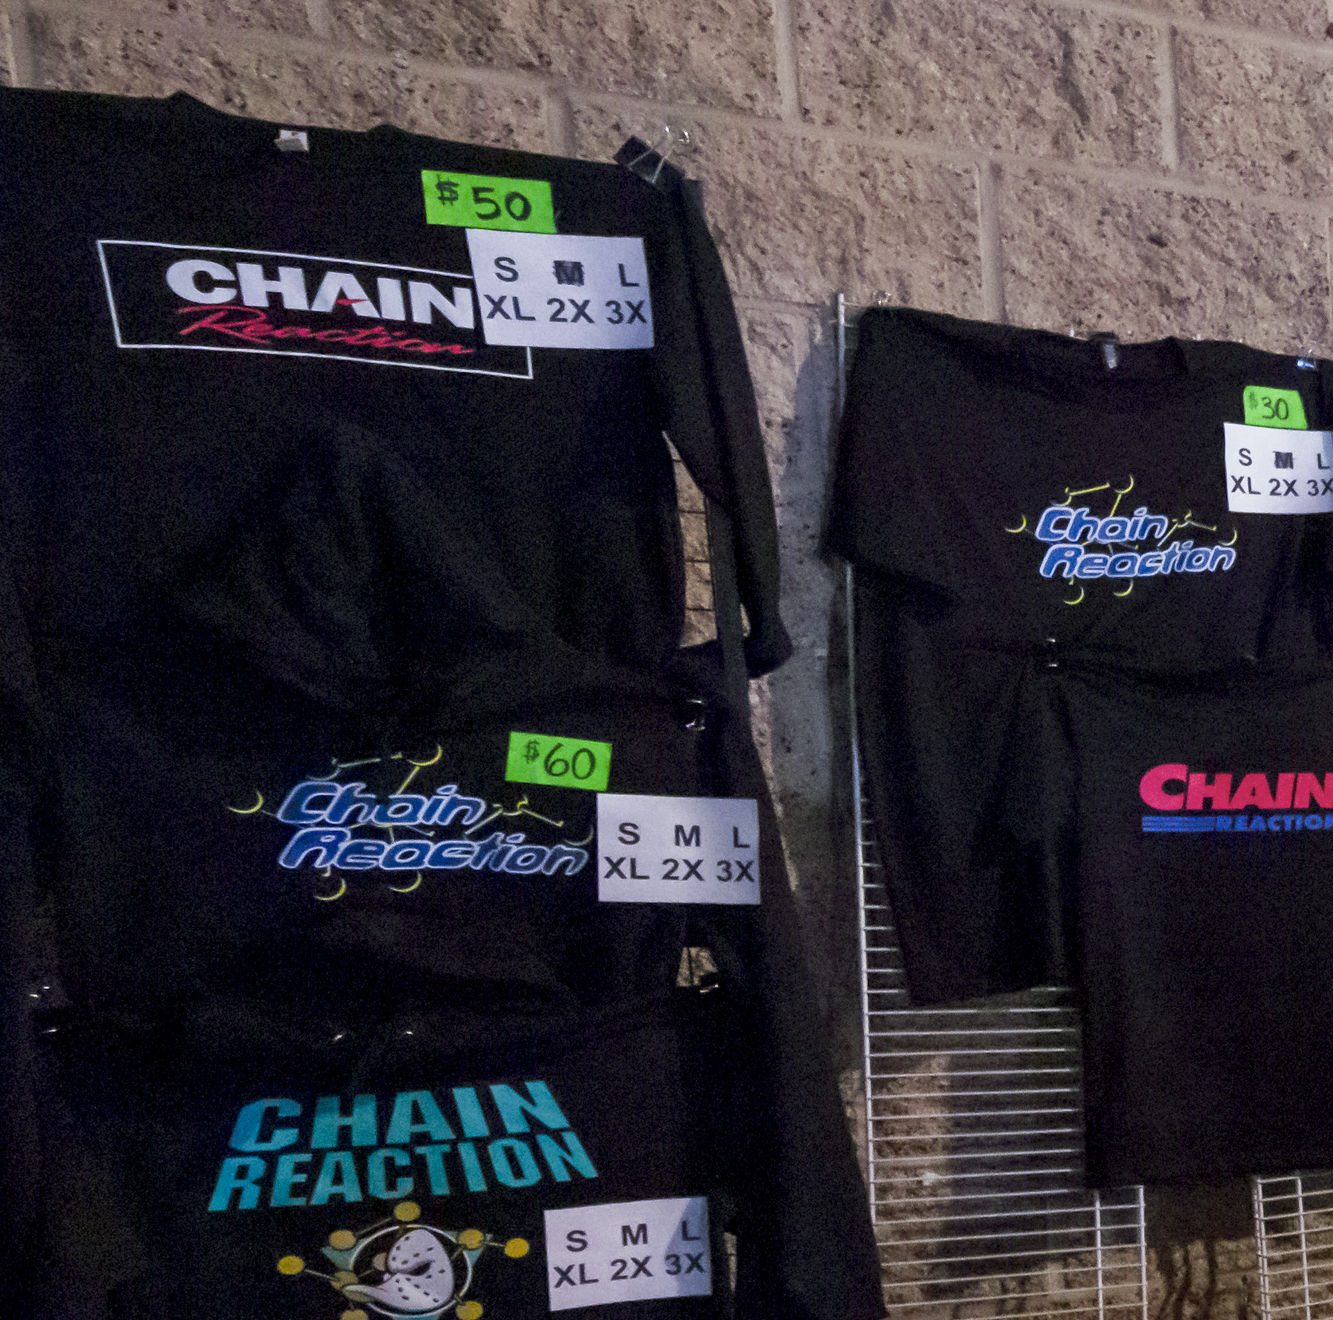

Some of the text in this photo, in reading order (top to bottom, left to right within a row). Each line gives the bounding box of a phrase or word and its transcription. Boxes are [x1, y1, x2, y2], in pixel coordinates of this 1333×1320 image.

[434, 173, 532, 221] $50
[494, 256, 519, 283] S
[619, 263, 640, 288] L
[165, 258, 475, 330] CHAIN
[486, 294, 649, 325] XL 2X 3X
[177, 304, 476, 355] Reaction
[1249, 391, 1290, 421] $30
[1238, 447, 1254, 467] S
[1317, 452, 1332, 470] L
[1230, 475, 1262, 496] XL
[1268, 478, 1300, 498] 2X
[1035, 506, 1169, 544] Chain
[1039, 541, 1237, 579] Reaction
[522, 740, 597, 780] $60
[276, 782, 487, 827] Chain
[278, 826, 590, 877] Reaction
[617, 822, 751, 849] S M L
[603, 856, 756, 883] XL 2X 3X
[228, 1080, 572, 1153] CHAIN
[207, 1130, 600, 1212] REACTION
[565, 1219, 701, 1253] S M L
[553, 1252, 707, 1290] XL 2X 3X
